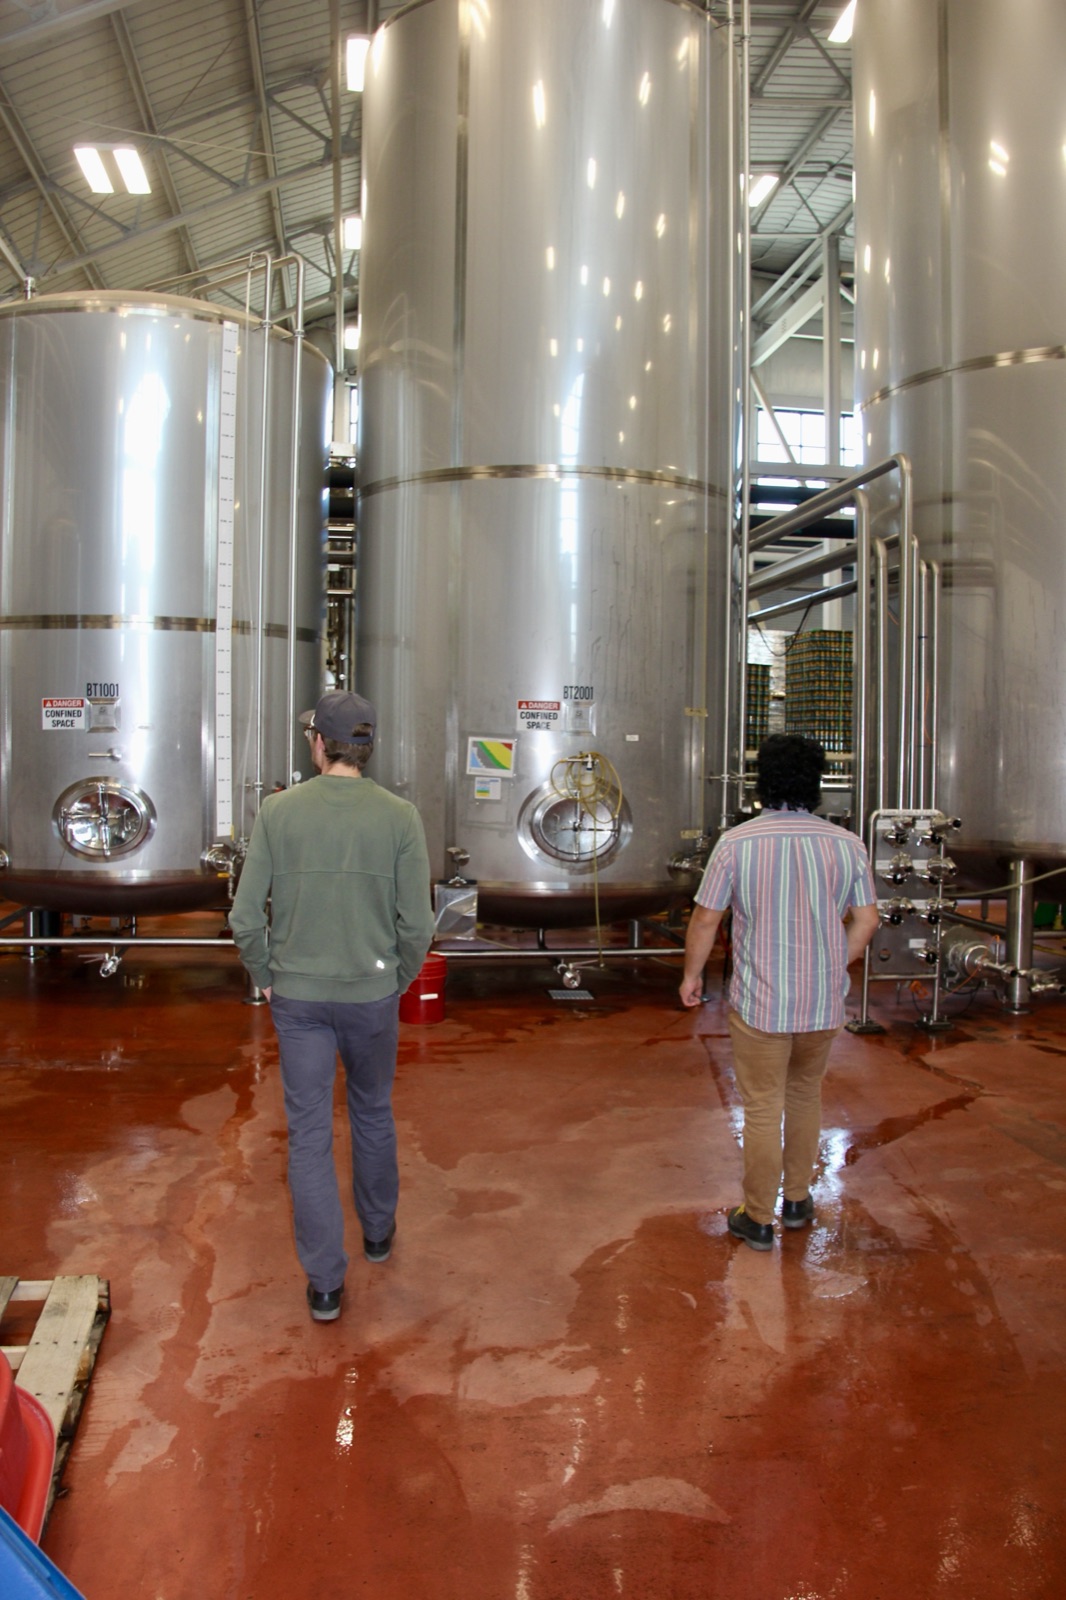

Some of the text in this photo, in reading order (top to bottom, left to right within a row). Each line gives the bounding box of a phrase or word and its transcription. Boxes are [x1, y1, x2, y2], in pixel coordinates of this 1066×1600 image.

[86, 683, 119, 697] BT1001
[563, 686, 594, 700] BT2001
[52, 699, 82, 707] DANGER
[528, 701, 559, 709] DANGER
[45, 709, 82, 718] CONFINED
[520, 711, 558, 720] CONFINED
[51, 719, 76, 728] SPACE
[526, 721, 551, 730] SPACE
